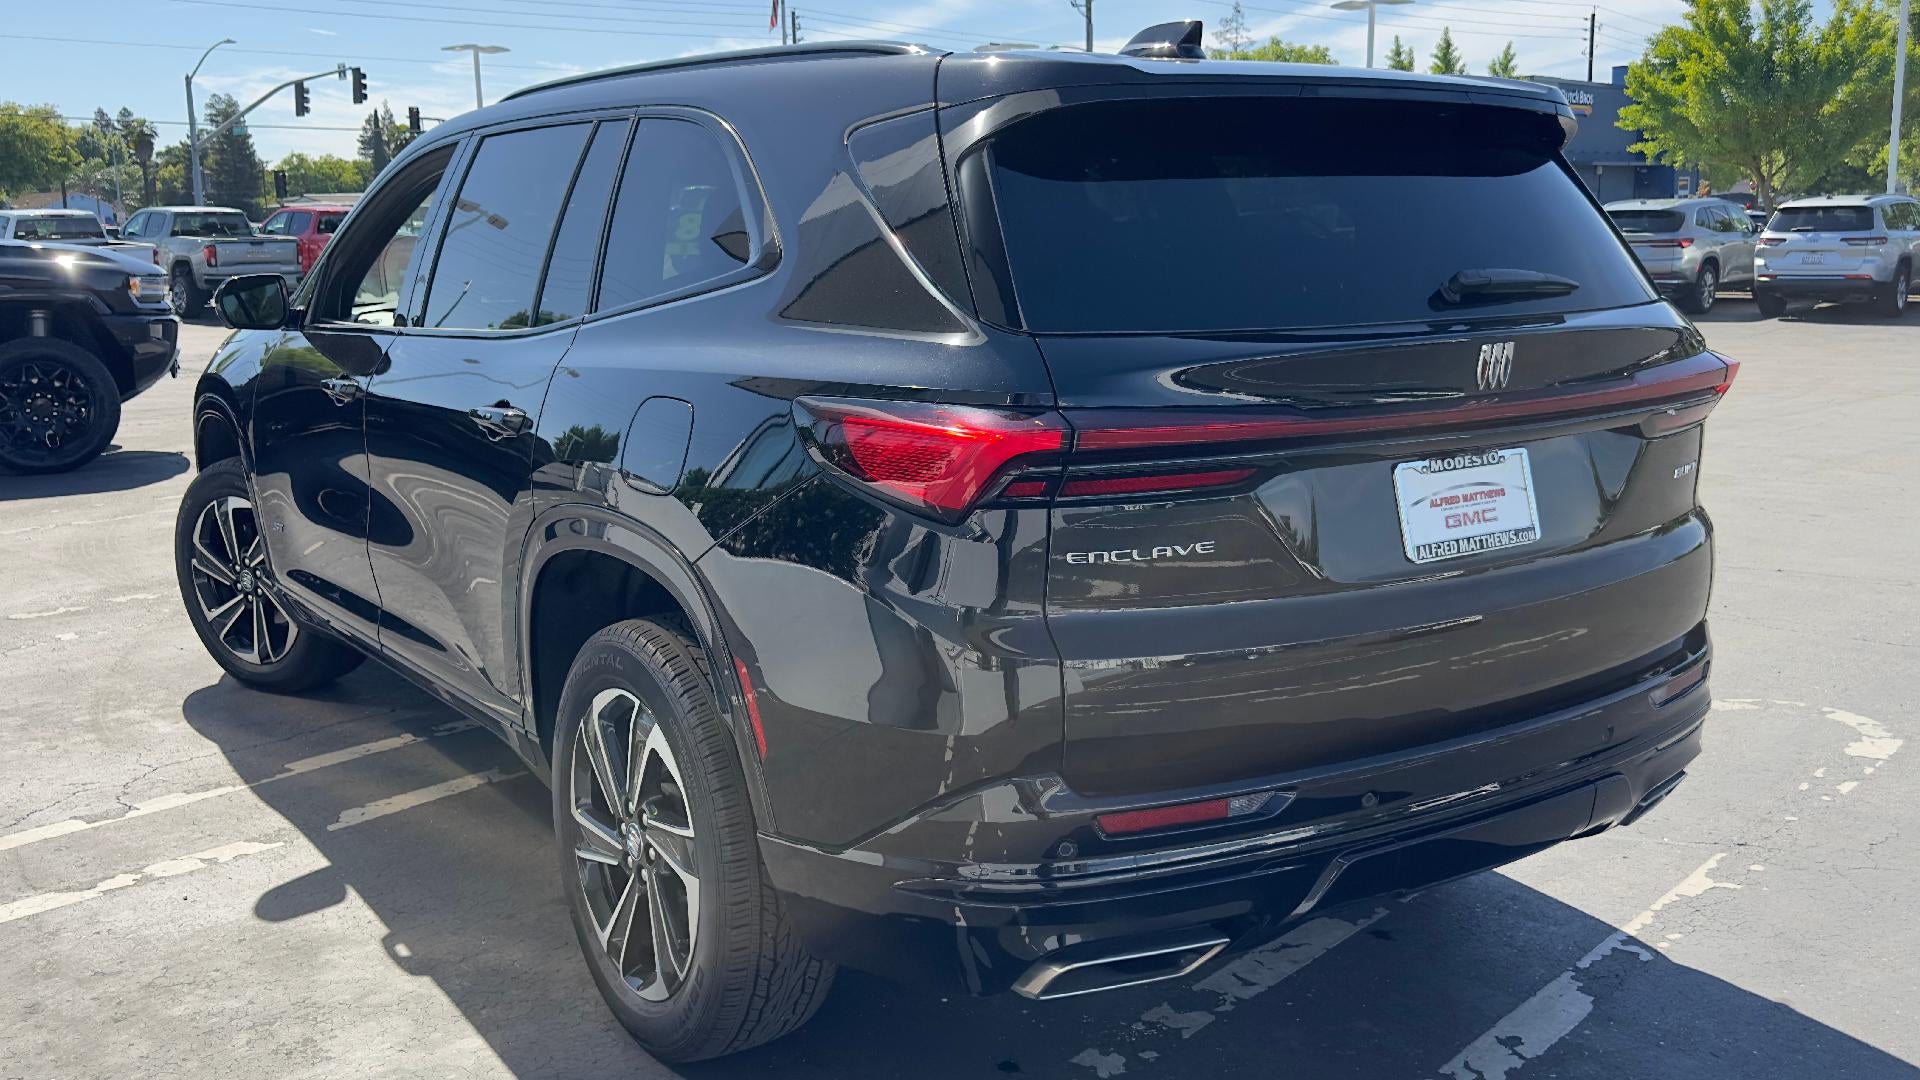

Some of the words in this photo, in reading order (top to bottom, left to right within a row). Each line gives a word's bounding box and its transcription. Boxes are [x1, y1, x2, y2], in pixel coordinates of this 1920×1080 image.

[1430, 451, 1499, 472] MODESTO
[1430, 495, 1460, 508] ALFRED
[1462, 488, 1506, 502] MATTHEWS
[1445, 507, 1499, 529] GMC
[1066, 540, 1215, 564] ENCLAVE
[1419, 542, 1458, 560] ALFRED
